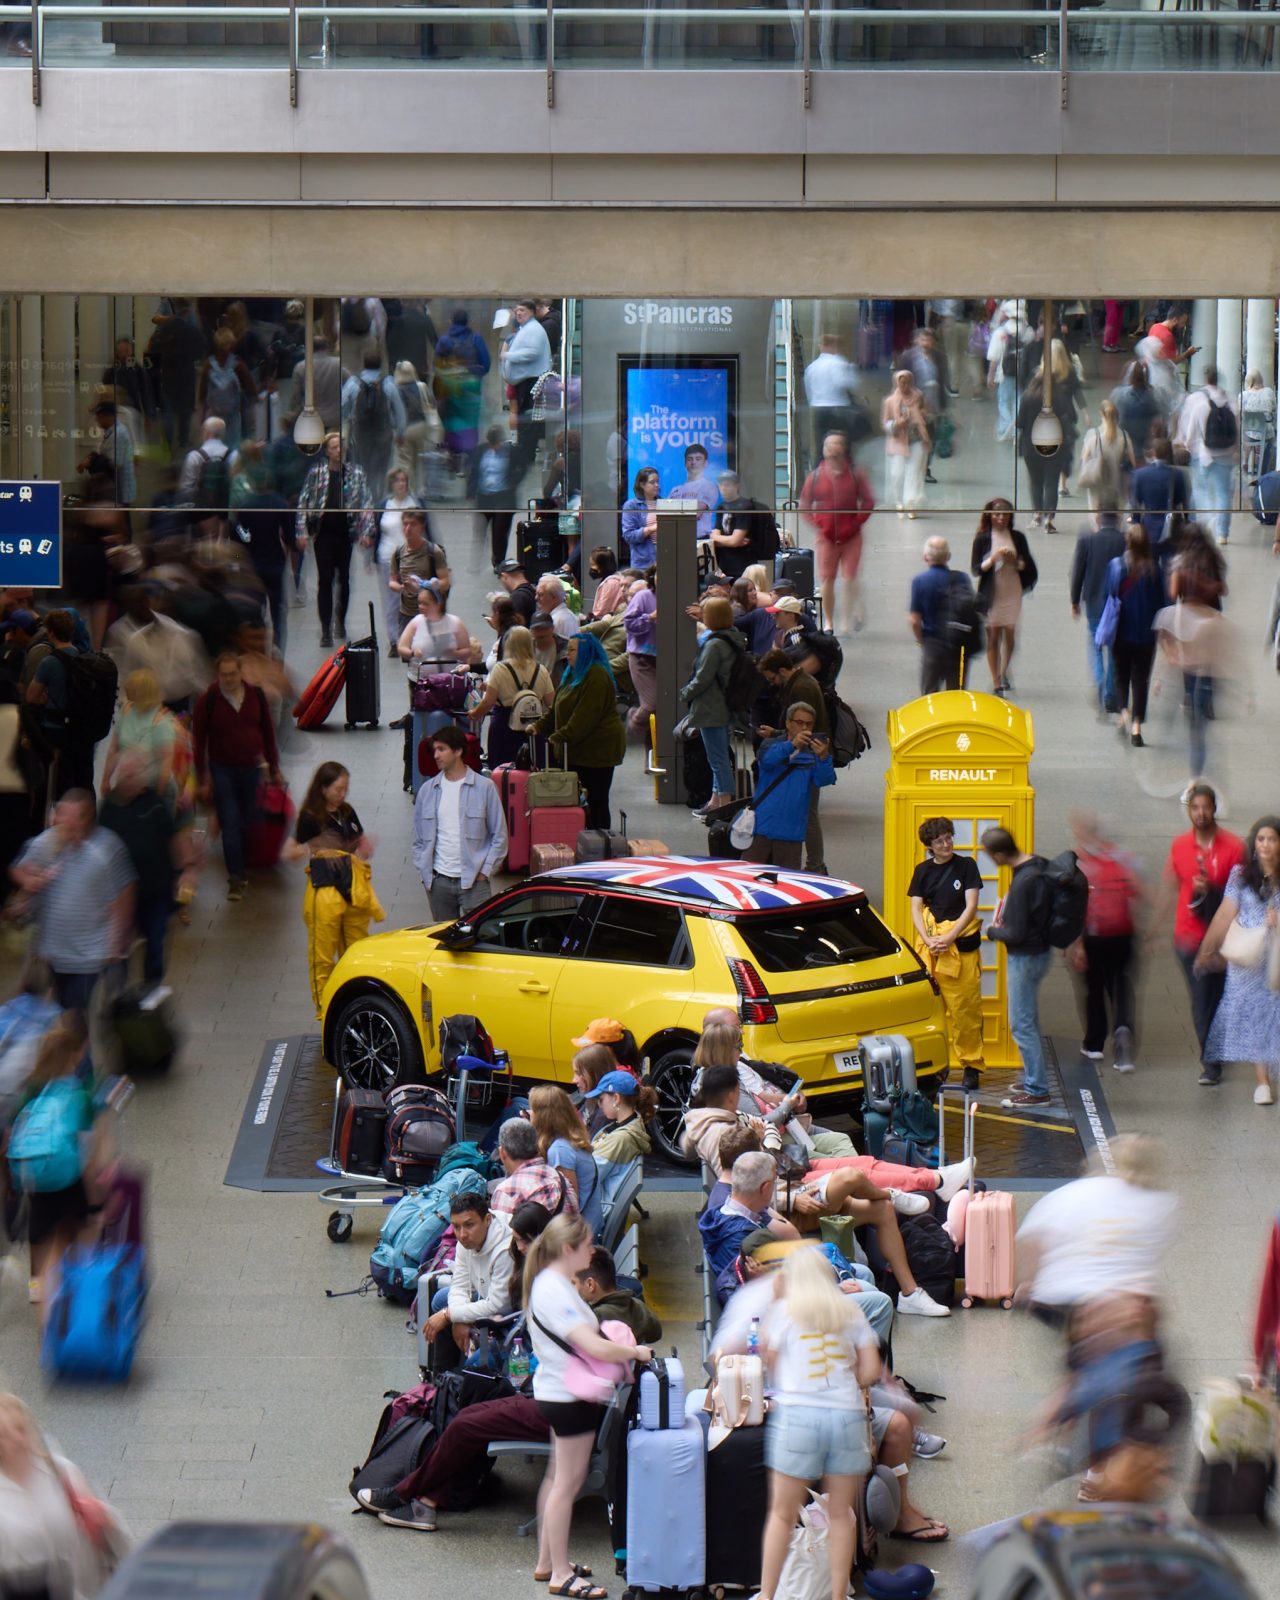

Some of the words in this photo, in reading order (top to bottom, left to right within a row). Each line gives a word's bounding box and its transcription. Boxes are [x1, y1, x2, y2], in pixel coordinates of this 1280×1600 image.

[651, 405, 669, 414] The
[632, 412, 717, 434] platform
[640, 431, 651, 443] is
[653, 431, 724, 453] yours
[929, 769, 997, 781] RENAULT
[842, 1055, 861, 1067] RE
